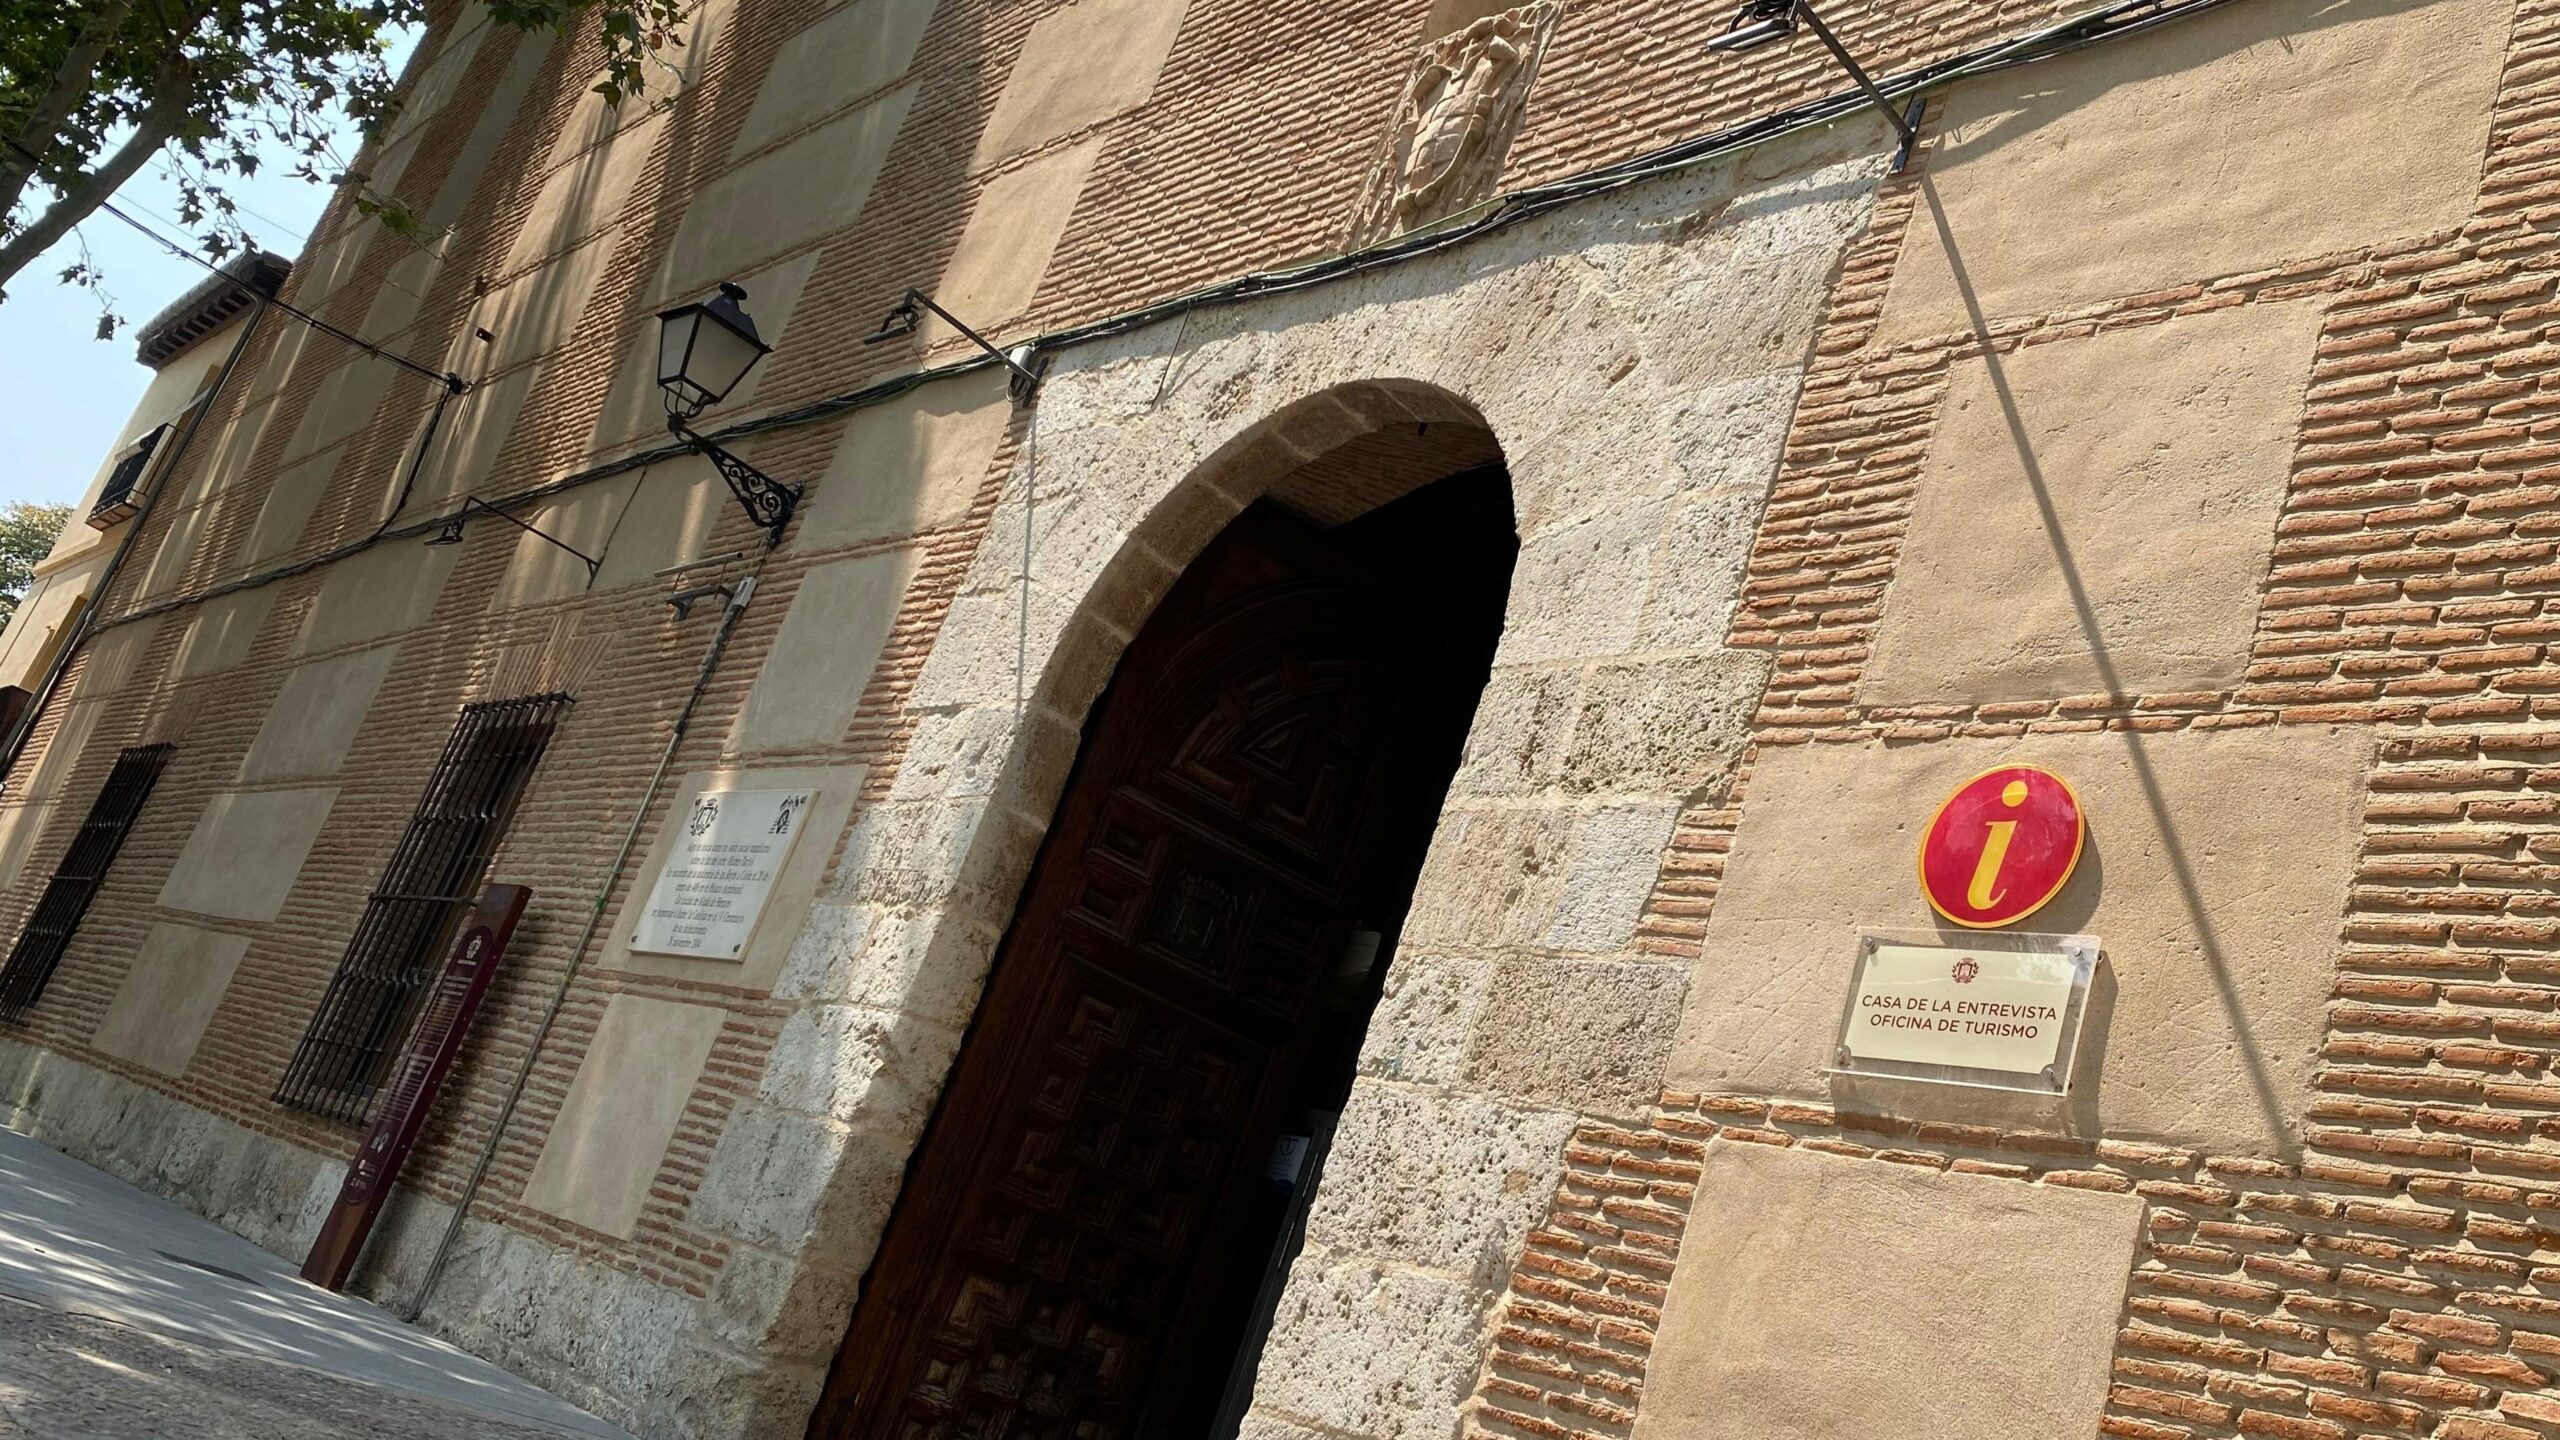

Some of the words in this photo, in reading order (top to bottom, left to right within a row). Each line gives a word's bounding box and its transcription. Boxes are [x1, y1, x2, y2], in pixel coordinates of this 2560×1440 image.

[1967, 780, 2029, 911] i
[1862, 995, 1902, 1009] CASA
[1906, 998, 1928, 1011] DE
[1931, 1000, 1951, 1013] LA
[1956, 1001, 2057, 1020] ENTREVISTA
[1870, 1014, 1932, 1030] OFICINA
[1937, 1020, 1960, 1032] DE
[1964, 1021, 2038, 1039] TURISMO
